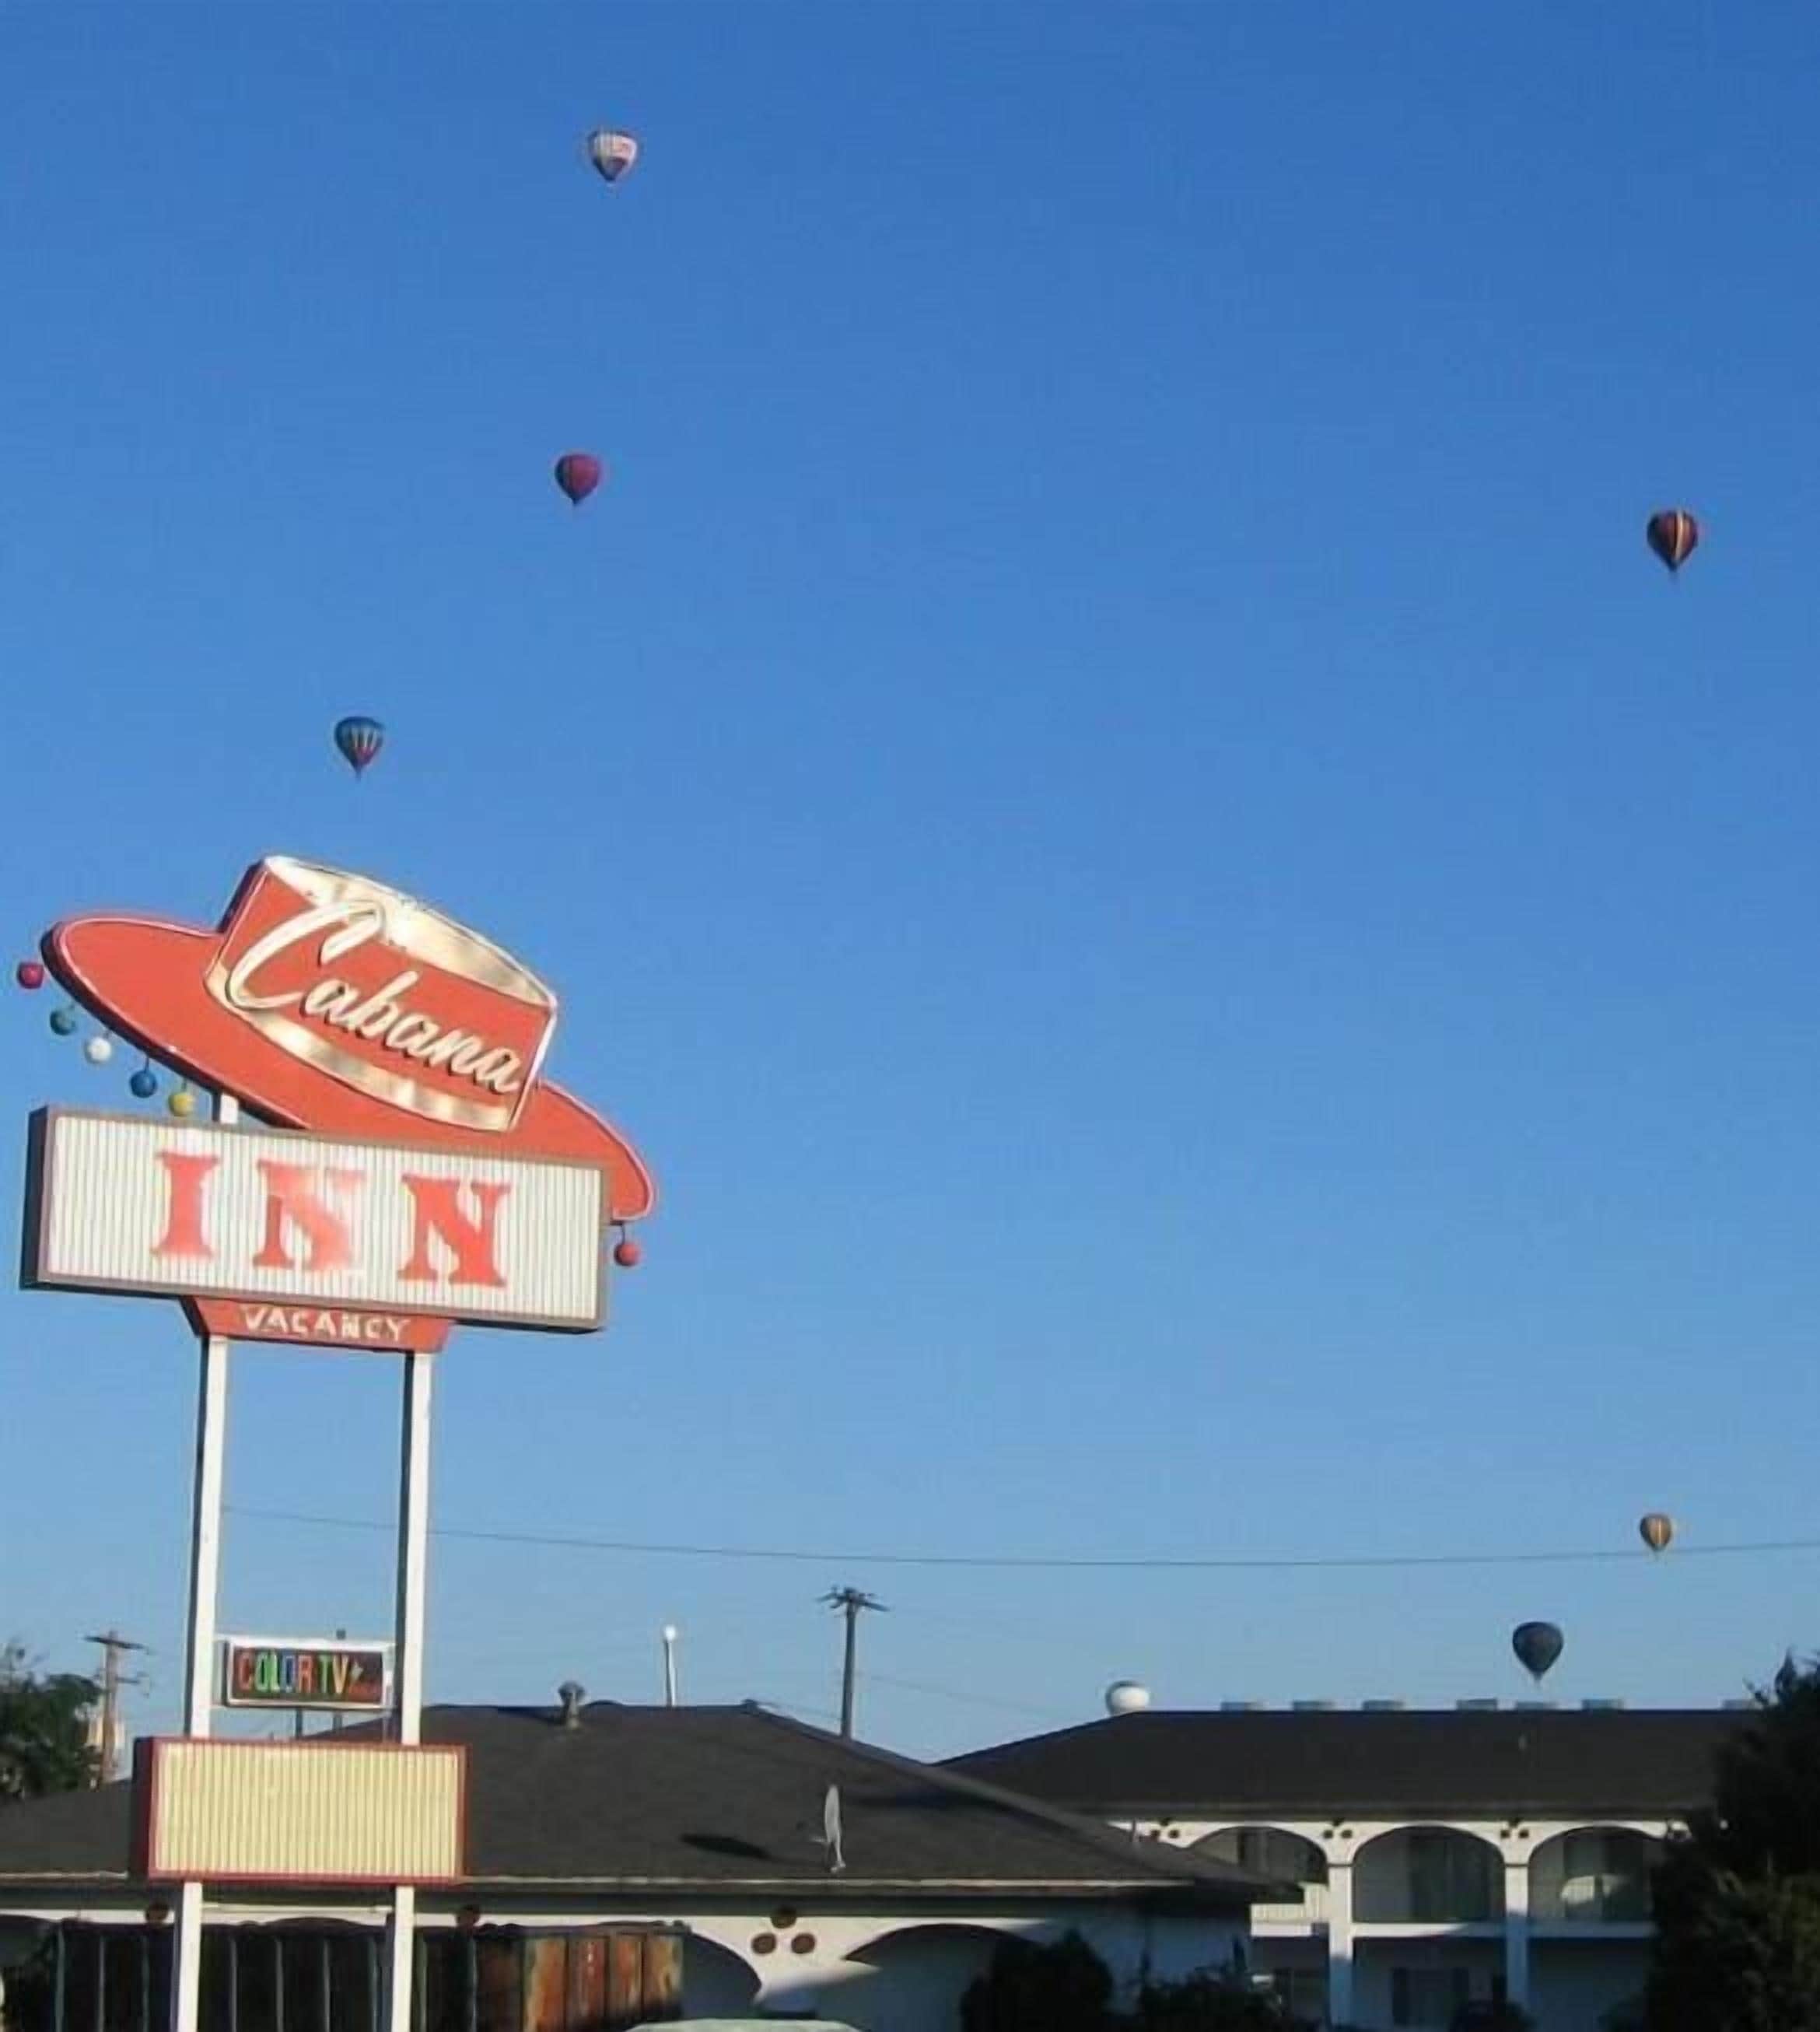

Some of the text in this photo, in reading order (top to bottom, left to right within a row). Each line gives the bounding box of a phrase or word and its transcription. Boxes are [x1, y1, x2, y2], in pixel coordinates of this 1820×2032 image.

[226, 900, 522, 1093] Cabana
[150, 1150, 512, 1288] INN
[240, 1305, 411, 1341] VACANCY
[237, 1649, 349, 1694] COLOR TV
